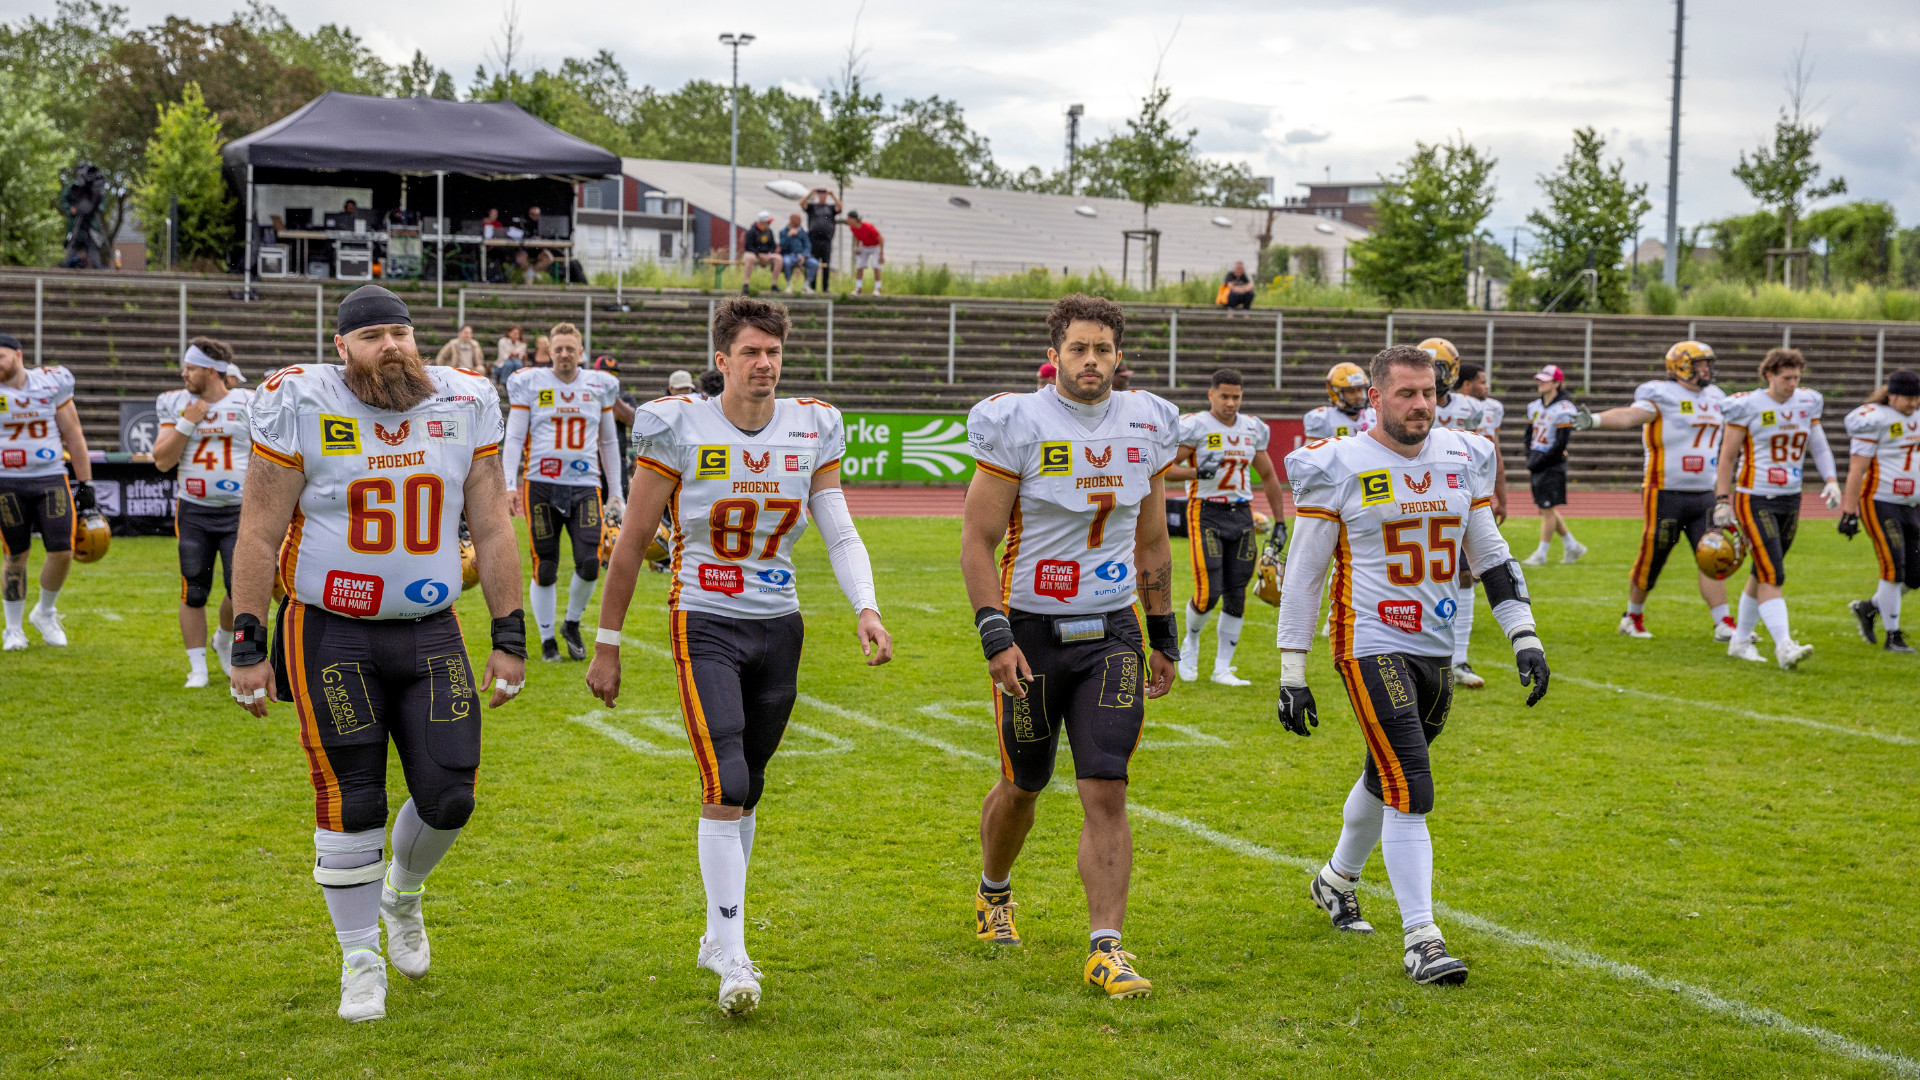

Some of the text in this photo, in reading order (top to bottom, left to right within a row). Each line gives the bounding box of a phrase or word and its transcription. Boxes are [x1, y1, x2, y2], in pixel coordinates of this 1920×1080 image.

[3, 420, 48, 441] 70
[327, 421, 354, 441] G
[550, 416, 587, 450] 10
[788, 431, 820, 439] PRIMOSPOR
[846, 417, 890, 443] rke
[1692, 423, 1720, 448] 77
[192, 435, 233, 471] 41
[1046, 447, 1068, 464] G
[1770, 432, 1808, 462] 89
[368, 450, 425, 470] PHOENIX
[704, 451, 726, 467] G
[842, 450, 889, 476] orf
[1899, 444, 1920, 471] 7
[1076, 475, 1124, 489] PHOENIX
[1218, 458, 1249, 490] 21
[732, 481, 780, 493] PHOENIX
[1366, 475, 1388, 493] G
[127, 498, 168, 516] ENERGY
[347, 473, 444, 555] 60
[1400, 500, 1448, 514] PHOENIX
[709, 498, 802, 561] 87
[1087, 491, 1116, 550] 7
[1382, 516, 1461, 587] 55
[704, 568, 737, 577] REWE
[1041, 573, 1072, 582] STEIDEL
[1042, 564, 1073, 574] REWE
[332, 588, 373, 600] STEIDEL
[333, 577, 375, 592] REWE
[1040, 581, 1072, 591] DEIN MARKT
[1094, 587, 1117, 596] suma
[330, 595, 372, 611] DEIN MARKT
[1384, 605, 1416, 614] REWE
[445, 659, 459, 683] GOLD
[1119, 677, 1129, 691] VIO
[1394, 679, 1408, 702] GOLD
[335, 684, 358, 727] VIO GOLD
[1021, 697, 1031, 715] VIO
[1022, 715, 1035, 738] GOLD
